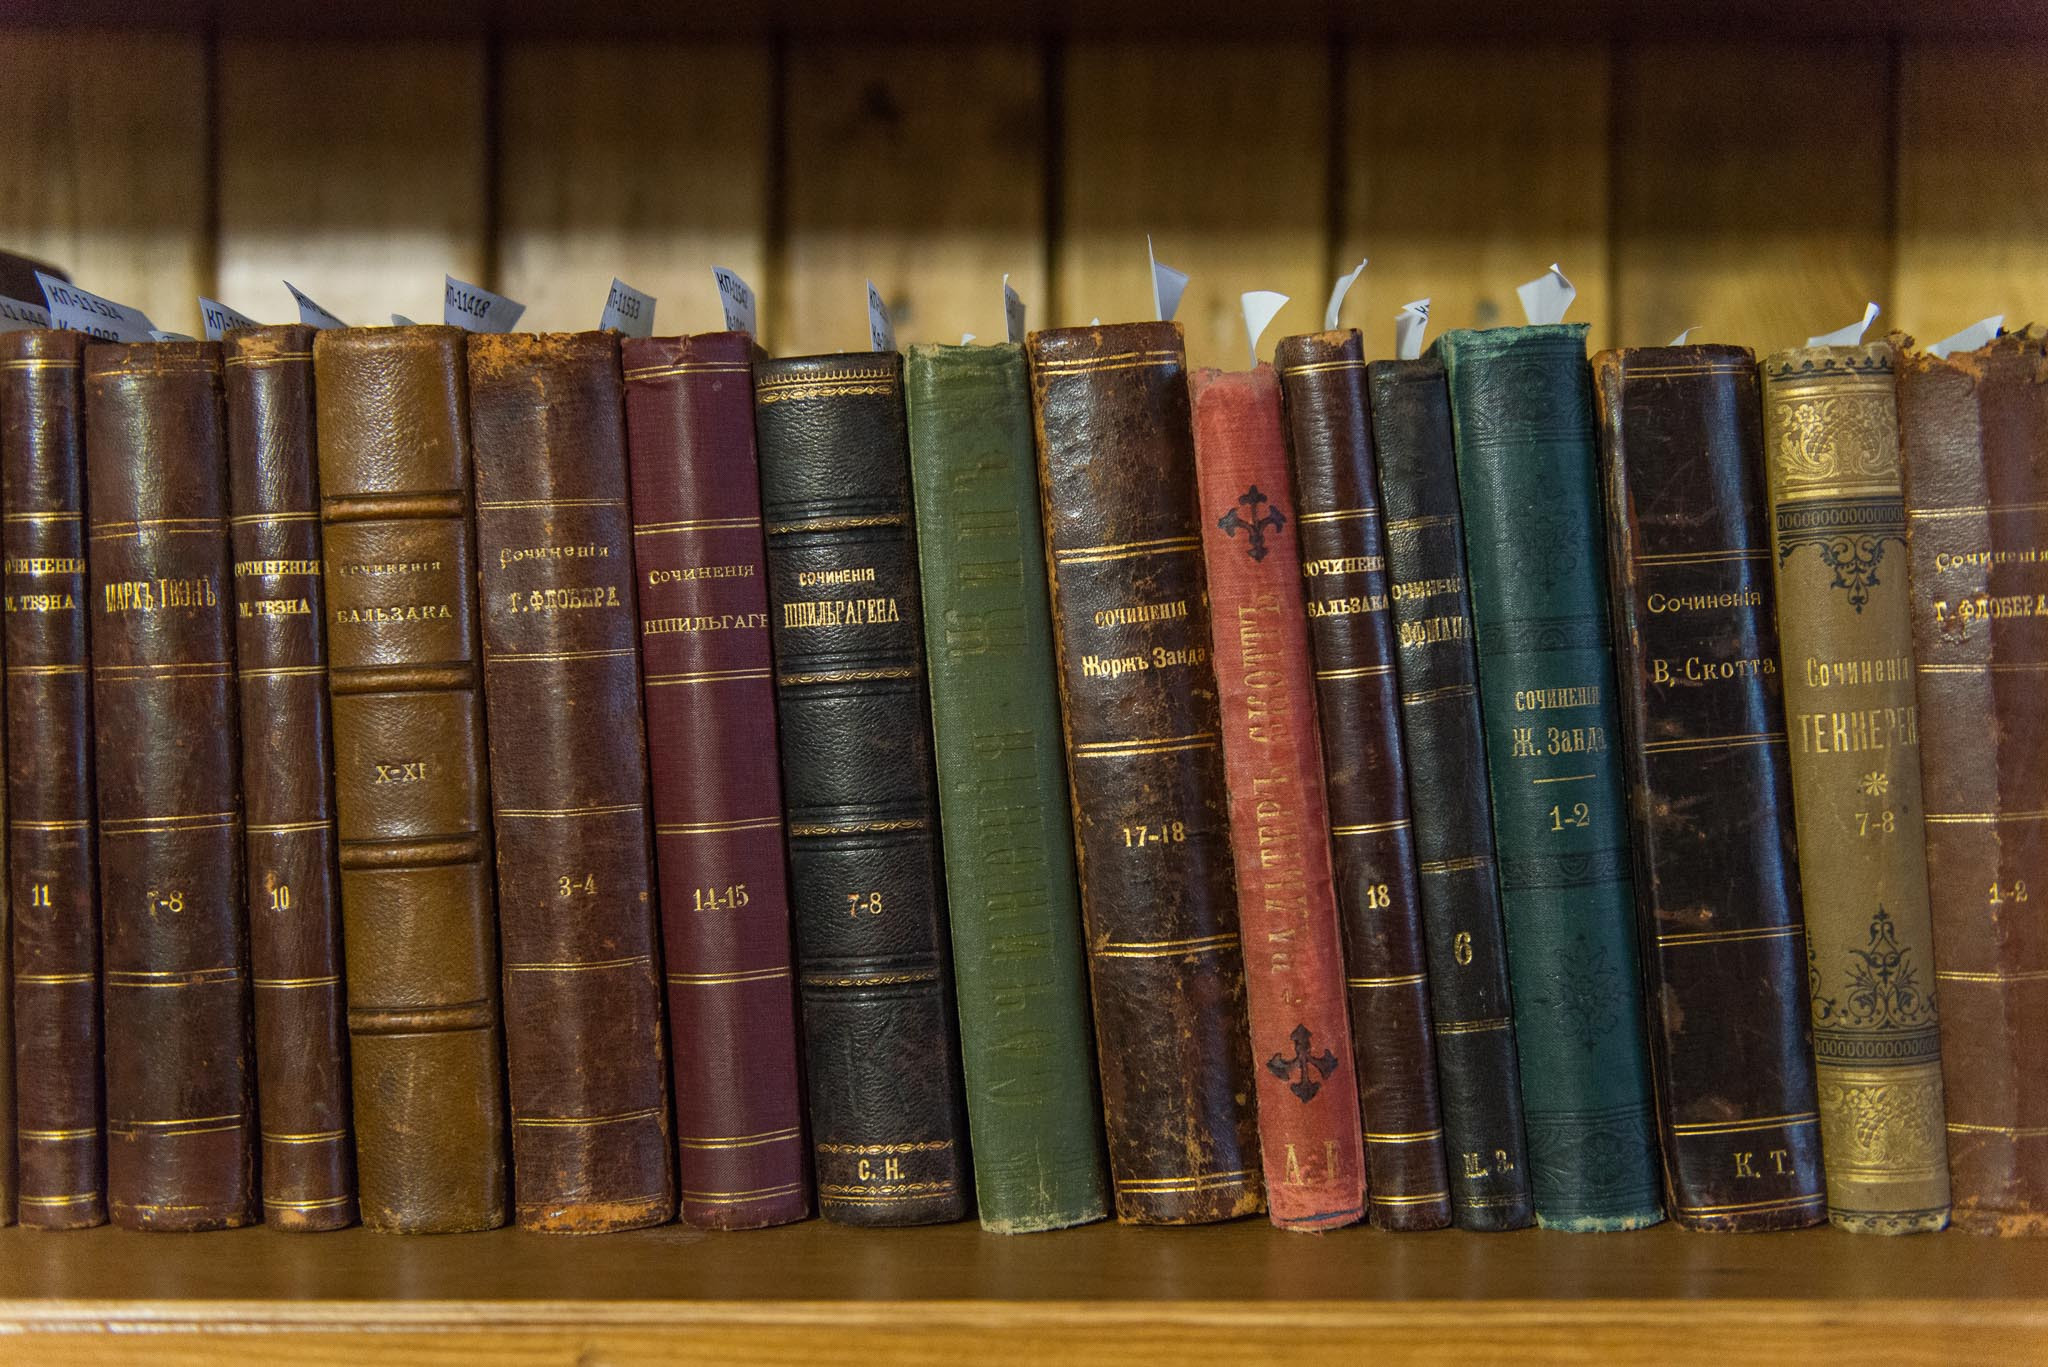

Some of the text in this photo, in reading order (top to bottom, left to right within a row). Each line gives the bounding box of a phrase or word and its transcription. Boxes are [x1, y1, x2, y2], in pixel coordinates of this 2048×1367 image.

[4, 557, 86, 577] ОЧИНЕНІЯ
[799, 567, 876, 587] СОЧИНЕНІЯ
[1550, 802, 1591, 832] 1-2
[1855, 810, 1894, 836] 7-8
[1123, 821, 1185, 848] 17-18
[32, 883, 51, 906] 11
[558, 873, 597, 896] 3-4
[1366, 884, 1391, 909] 18
[271, 885, 289, 910] 10
[693, 884, 749, 912] 14-15
[847, 892, 882, 917] 7-8
[1454, 931, 1473, 966] 6
[858, 1157, 906, 1181] С. Н.
[1733, 1149, 1796, 1178] К. Т.
